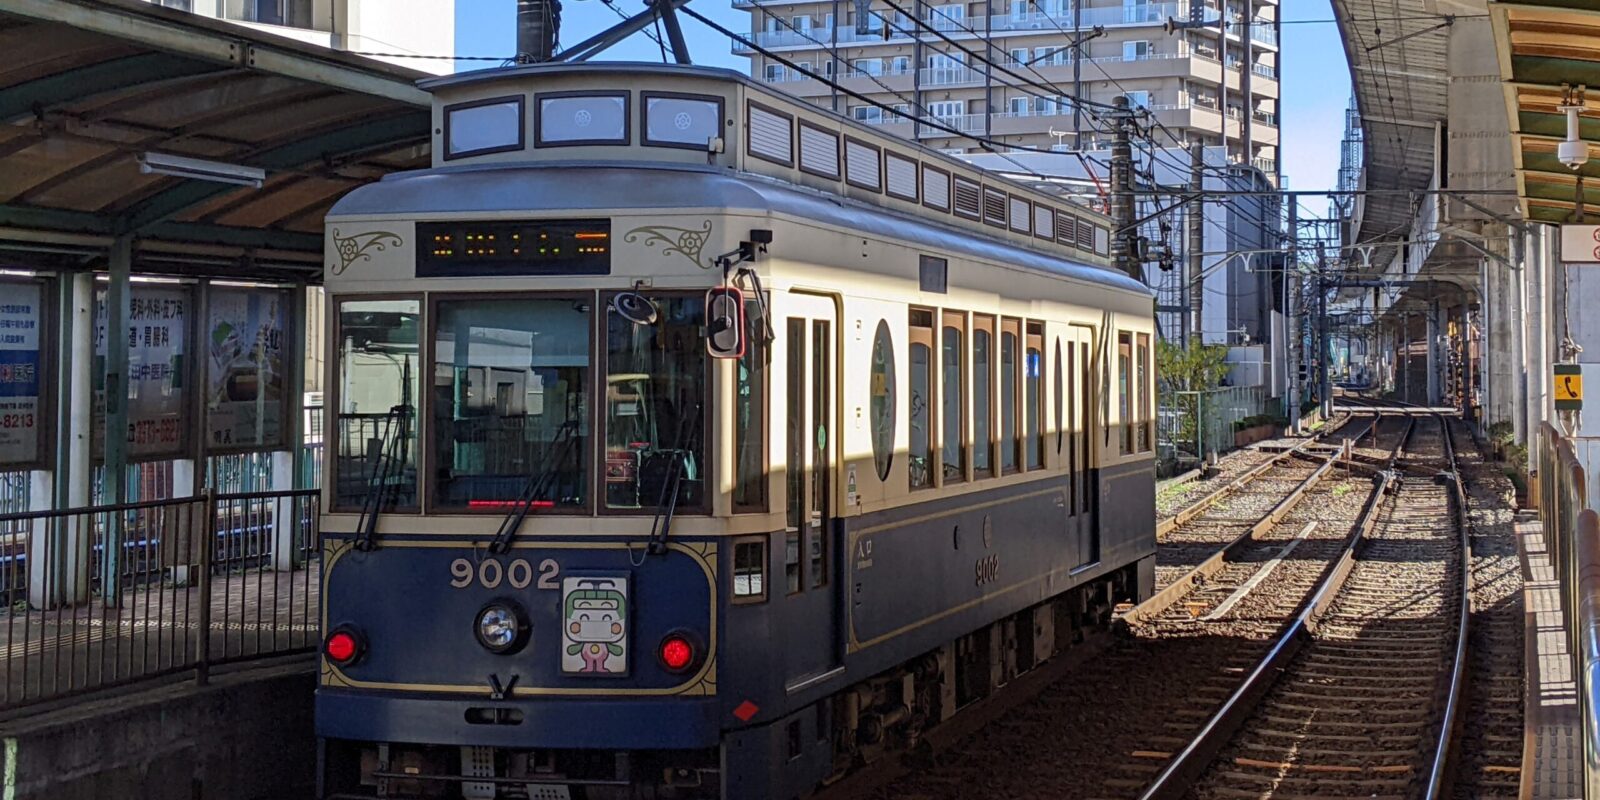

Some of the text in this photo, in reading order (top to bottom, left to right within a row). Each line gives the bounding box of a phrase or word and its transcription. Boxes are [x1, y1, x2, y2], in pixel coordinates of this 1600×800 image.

[857, 539, 872, 558] 入口
[450, 558, 560, 590] 9002
[976, 553, 999, 587] 9002
